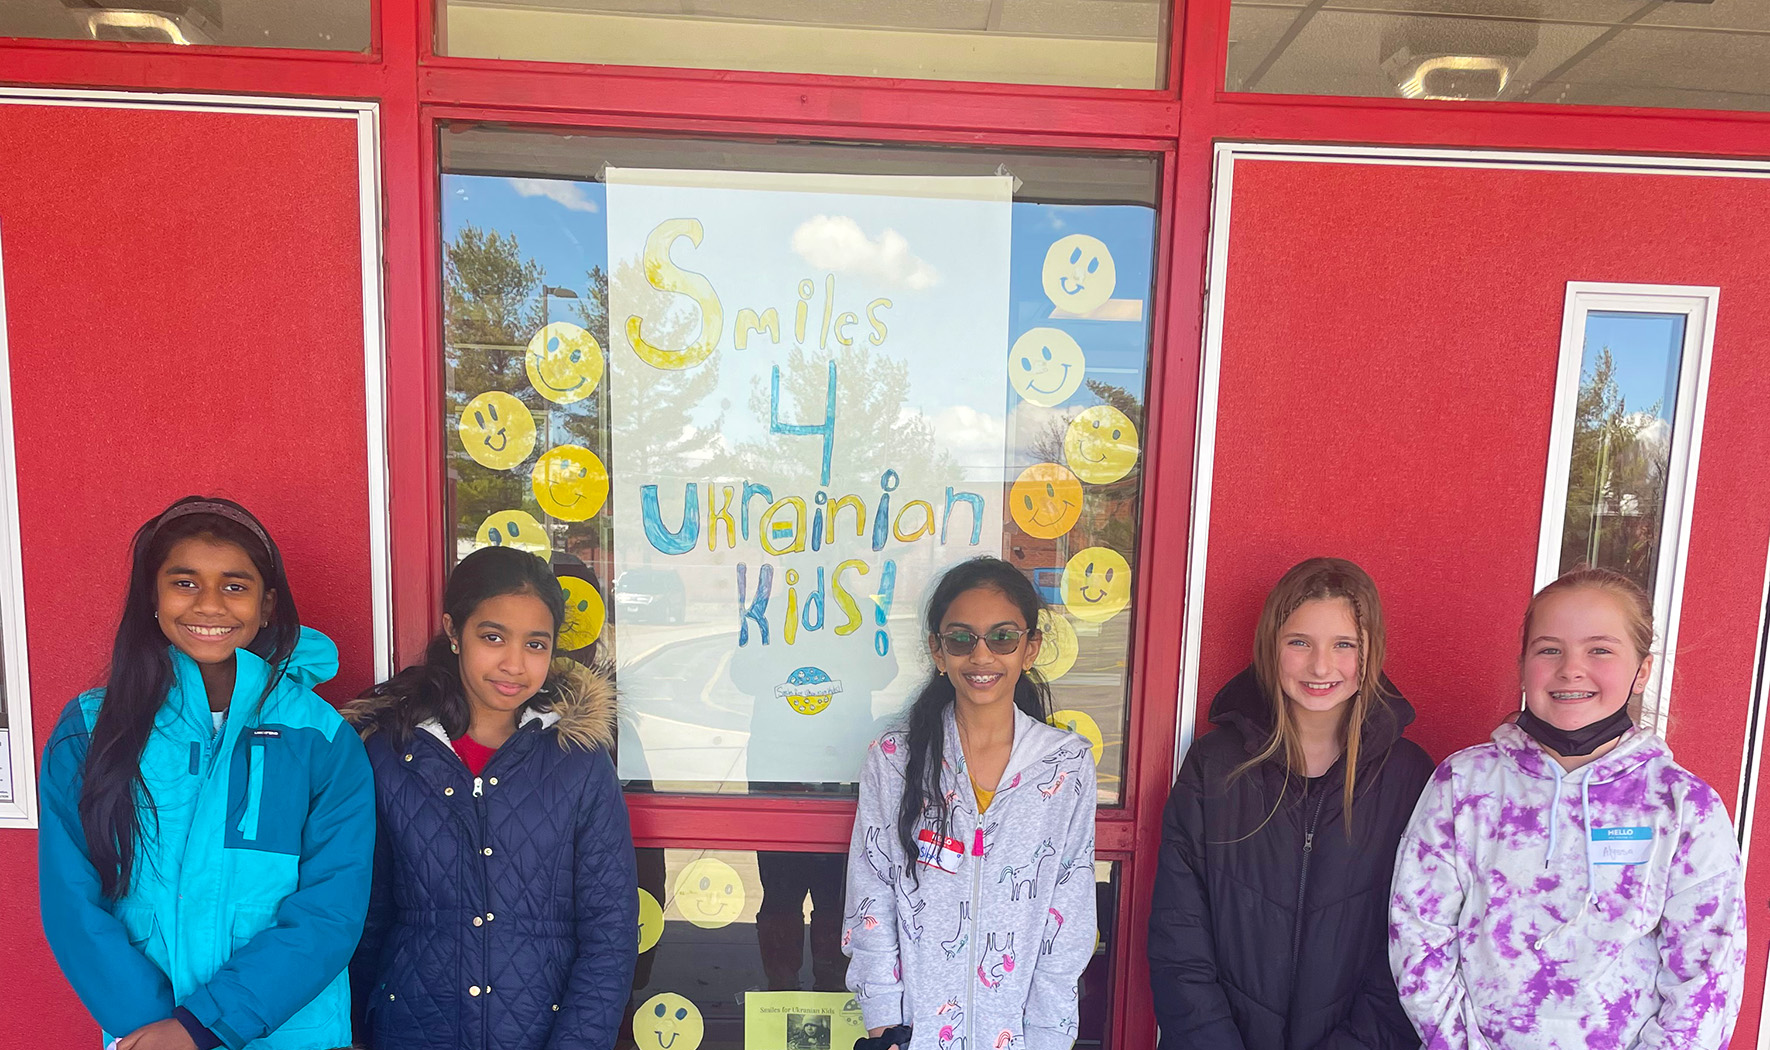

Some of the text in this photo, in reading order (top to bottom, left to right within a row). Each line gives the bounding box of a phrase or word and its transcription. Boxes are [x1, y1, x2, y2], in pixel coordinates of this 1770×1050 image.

[625, 218, 893, 370] Smiles
[770, 359, 837, 487] 4
[640, 468, 985, 555] Ukrainian
